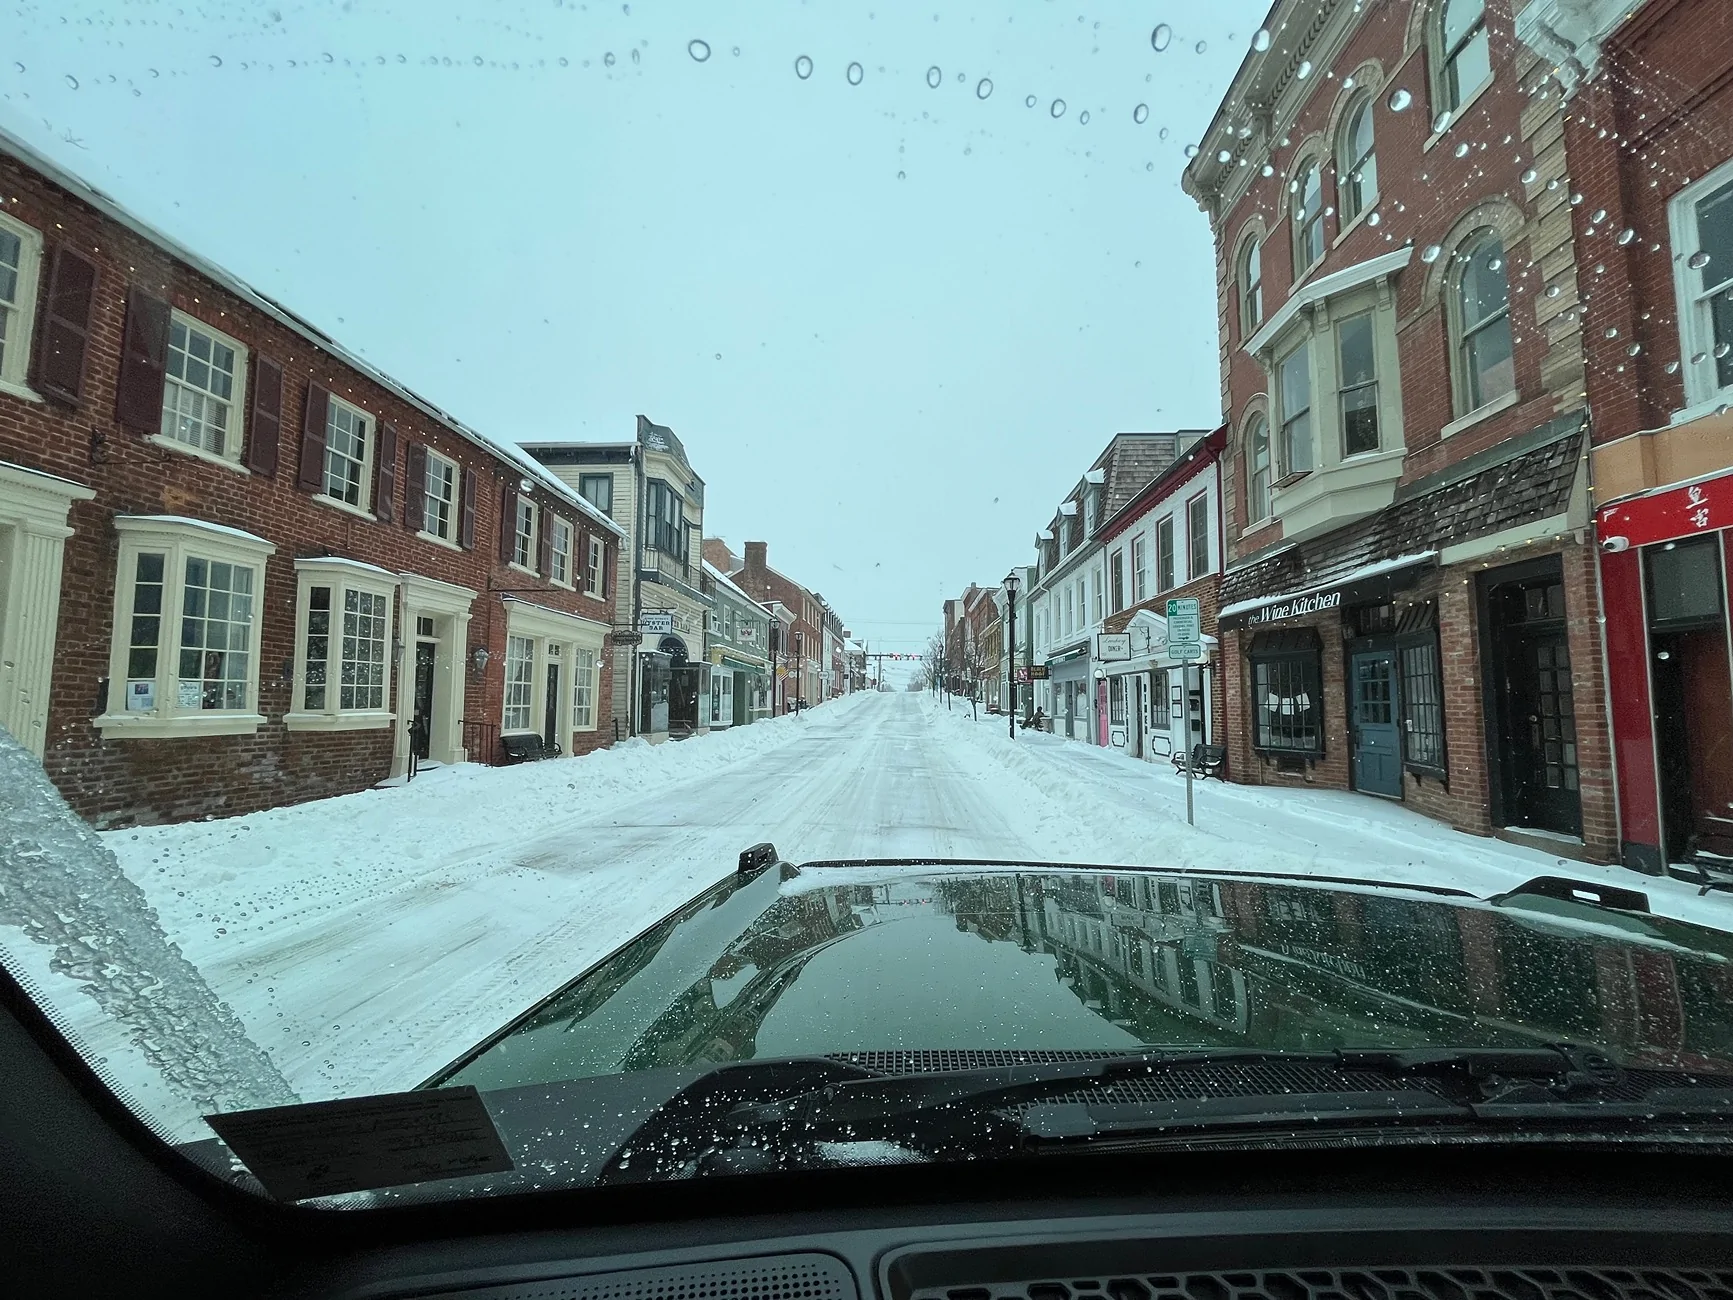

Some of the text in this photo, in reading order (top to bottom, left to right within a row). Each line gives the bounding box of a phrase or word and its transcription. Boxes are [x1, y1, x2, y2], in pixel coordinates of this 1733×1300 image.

[1168, 603, 1177, 613] 20
[1248, 592, 1341, 625] the Wine Kitchen
